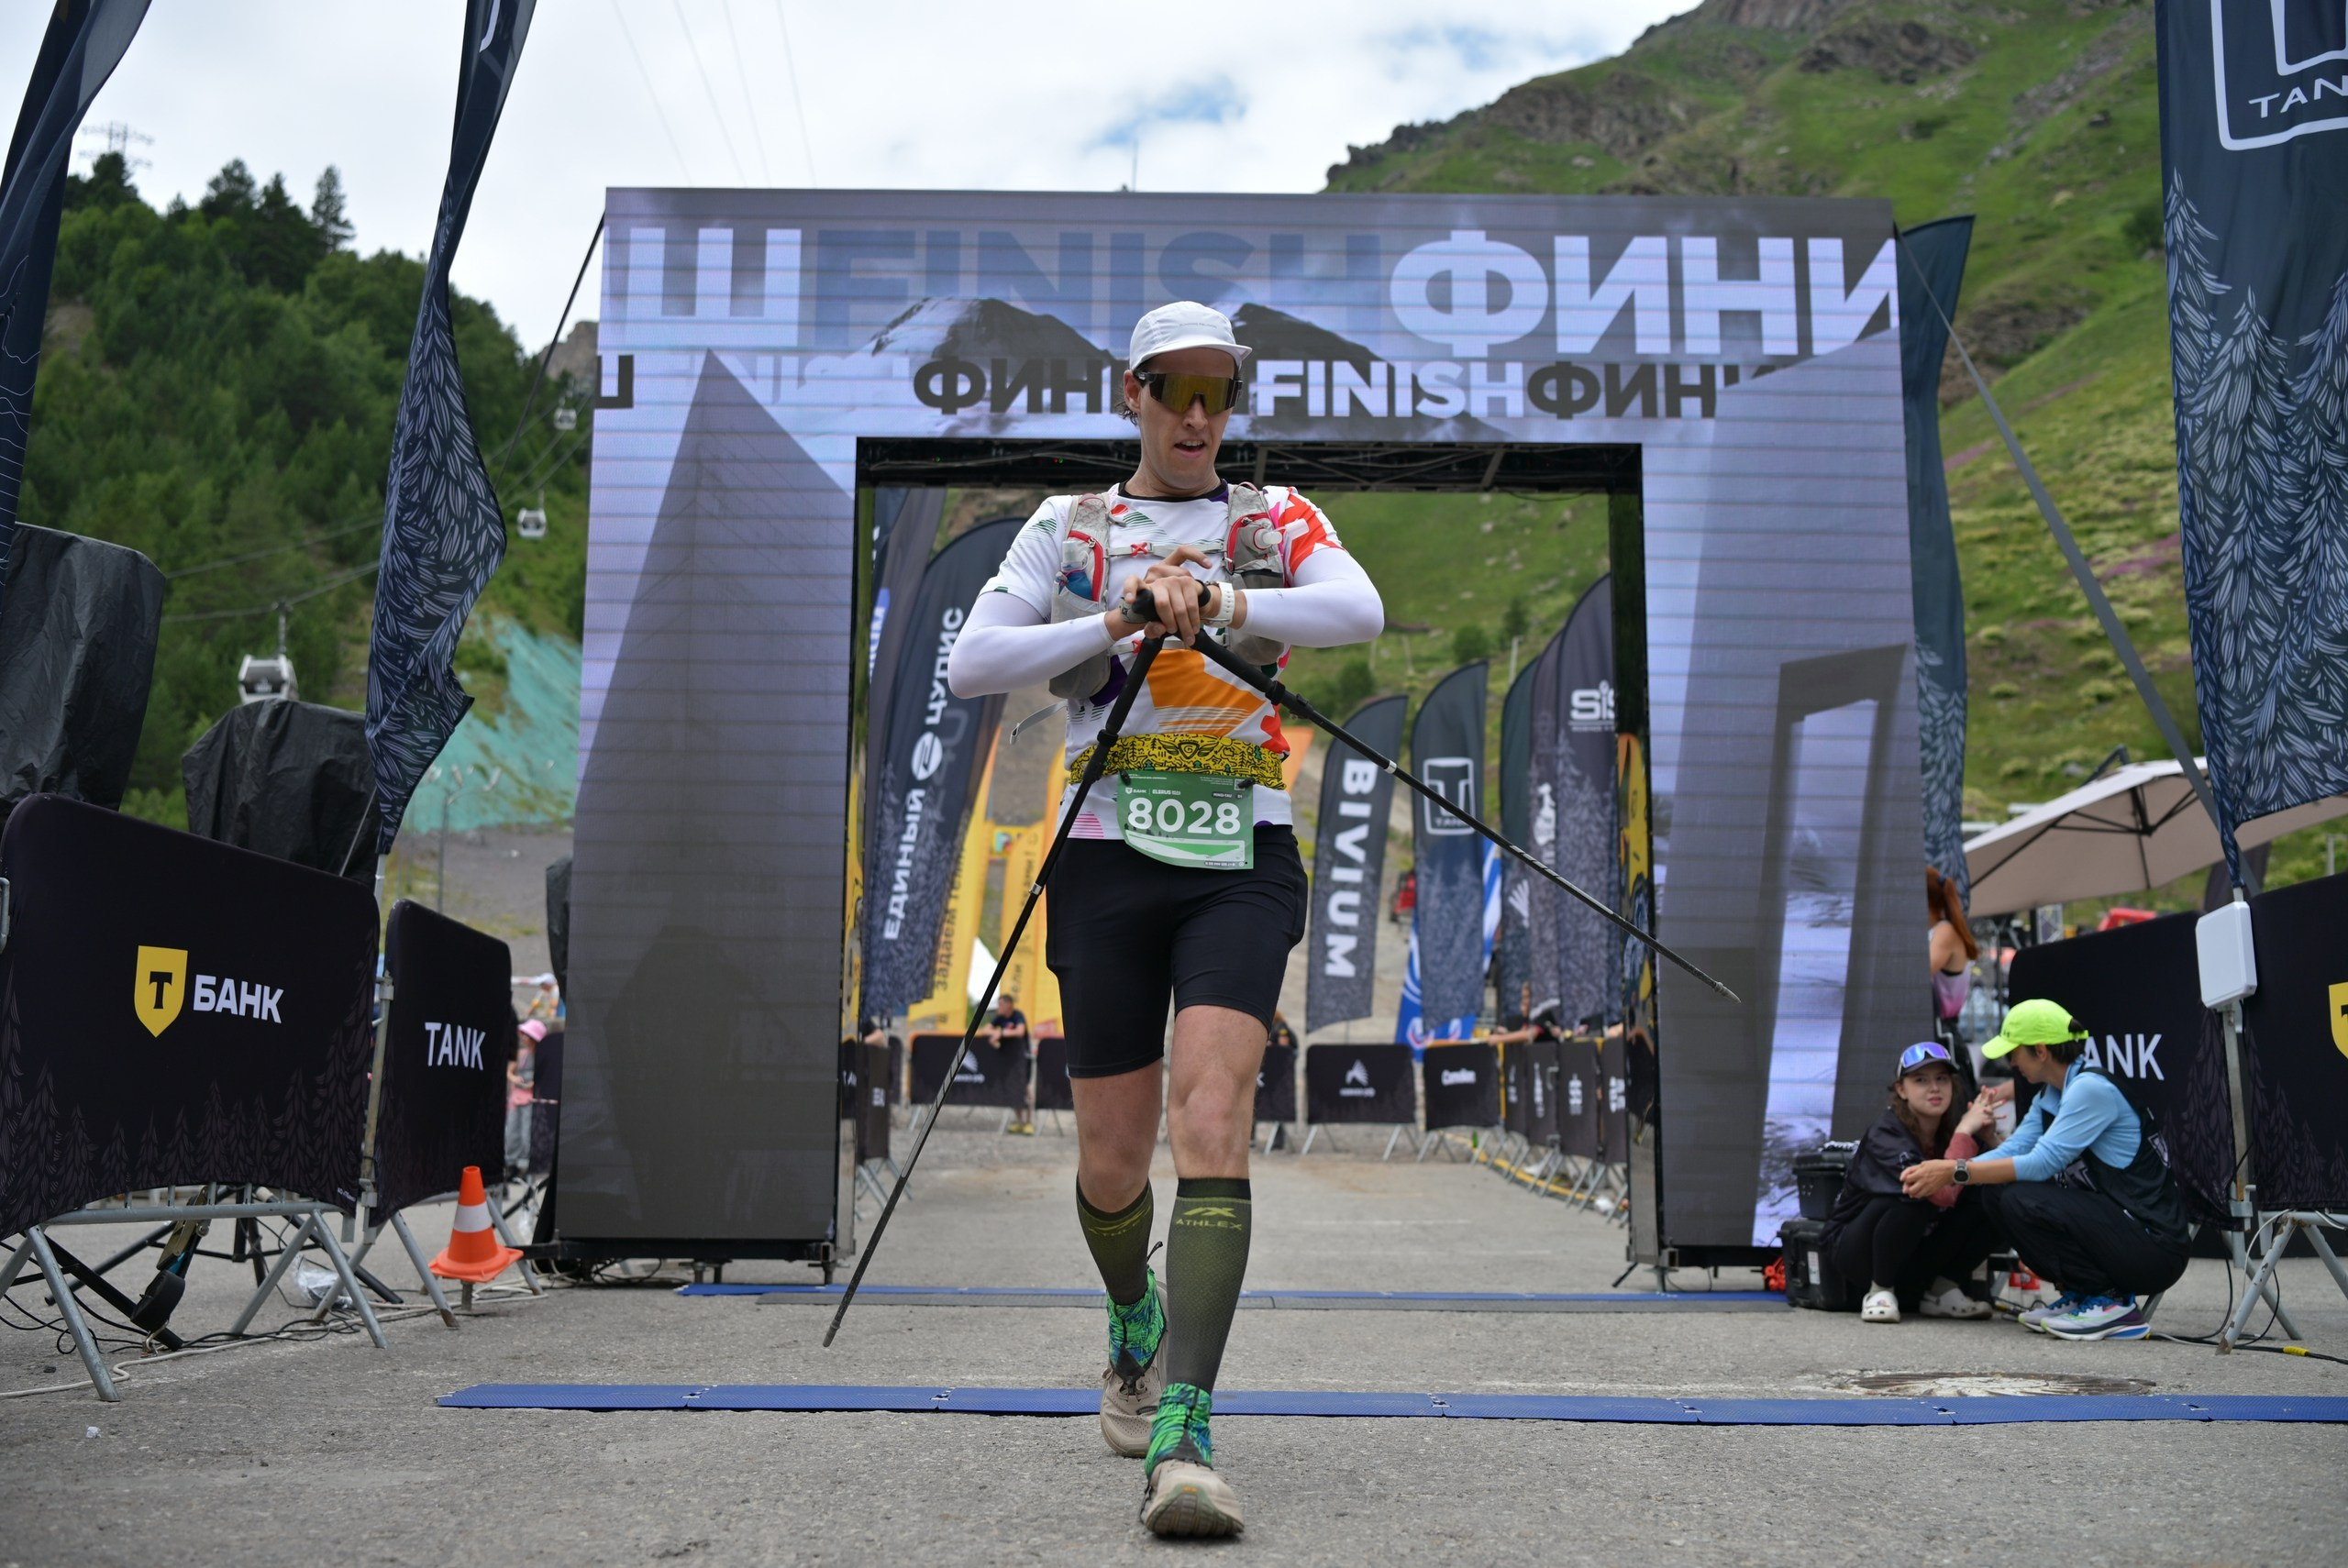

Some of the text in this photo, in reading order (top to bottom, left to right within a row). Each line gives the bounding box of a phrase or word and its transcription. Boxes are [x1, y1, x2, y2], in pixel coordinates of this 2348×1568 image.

[1257, 359, 1524, 418] FINISH
[1527, 361, 1777, 421] ФИН
[883, 607, 964, 939] ЕДИНЫЙ ЦУПИС
[1127, 797, 1241, 835] 8028
[1324, 758, 1377, 979] BIVIUM
[193, 974, 284, 1024] БАНК
[424, 1021, 487, 1071] TANK
[2083, 1033, 2165, 1081] ANK
[1175, 1217, 1242, 1231] ATHLEX
